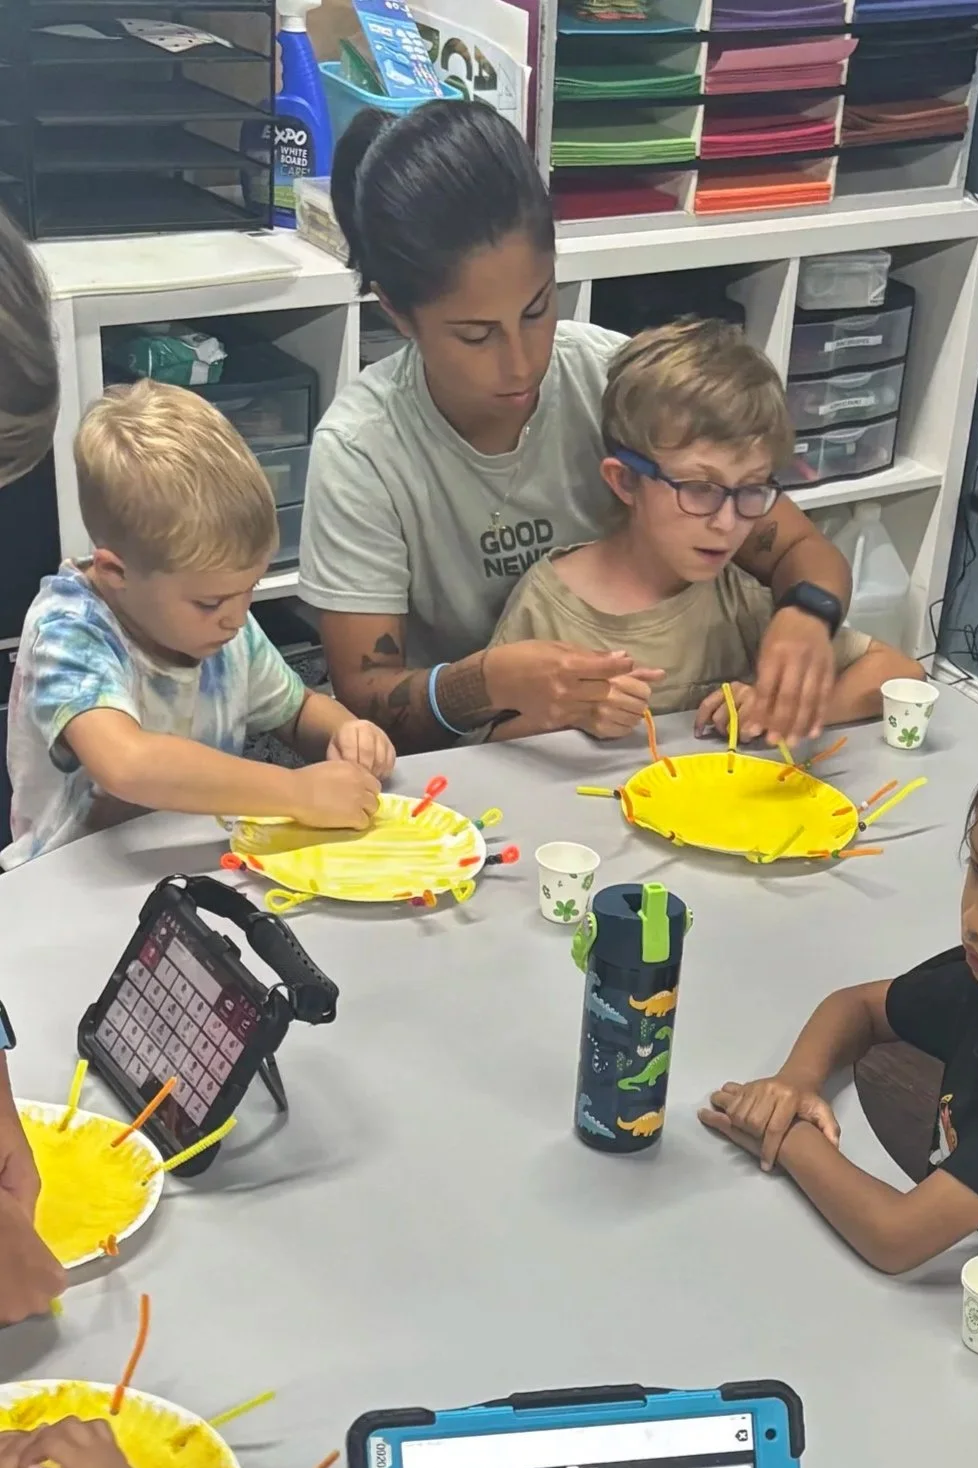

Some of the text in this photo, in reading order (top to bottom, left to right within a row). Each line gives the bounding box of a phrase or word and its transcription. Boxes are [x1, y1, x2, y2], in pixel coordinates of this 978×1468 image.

[261, 124, 308, 146] EXPO
[280, 145, 308, 158] WHITE
[280, 154, 309, 167] BOARD
[480, 518, 554, 555] GOOD
